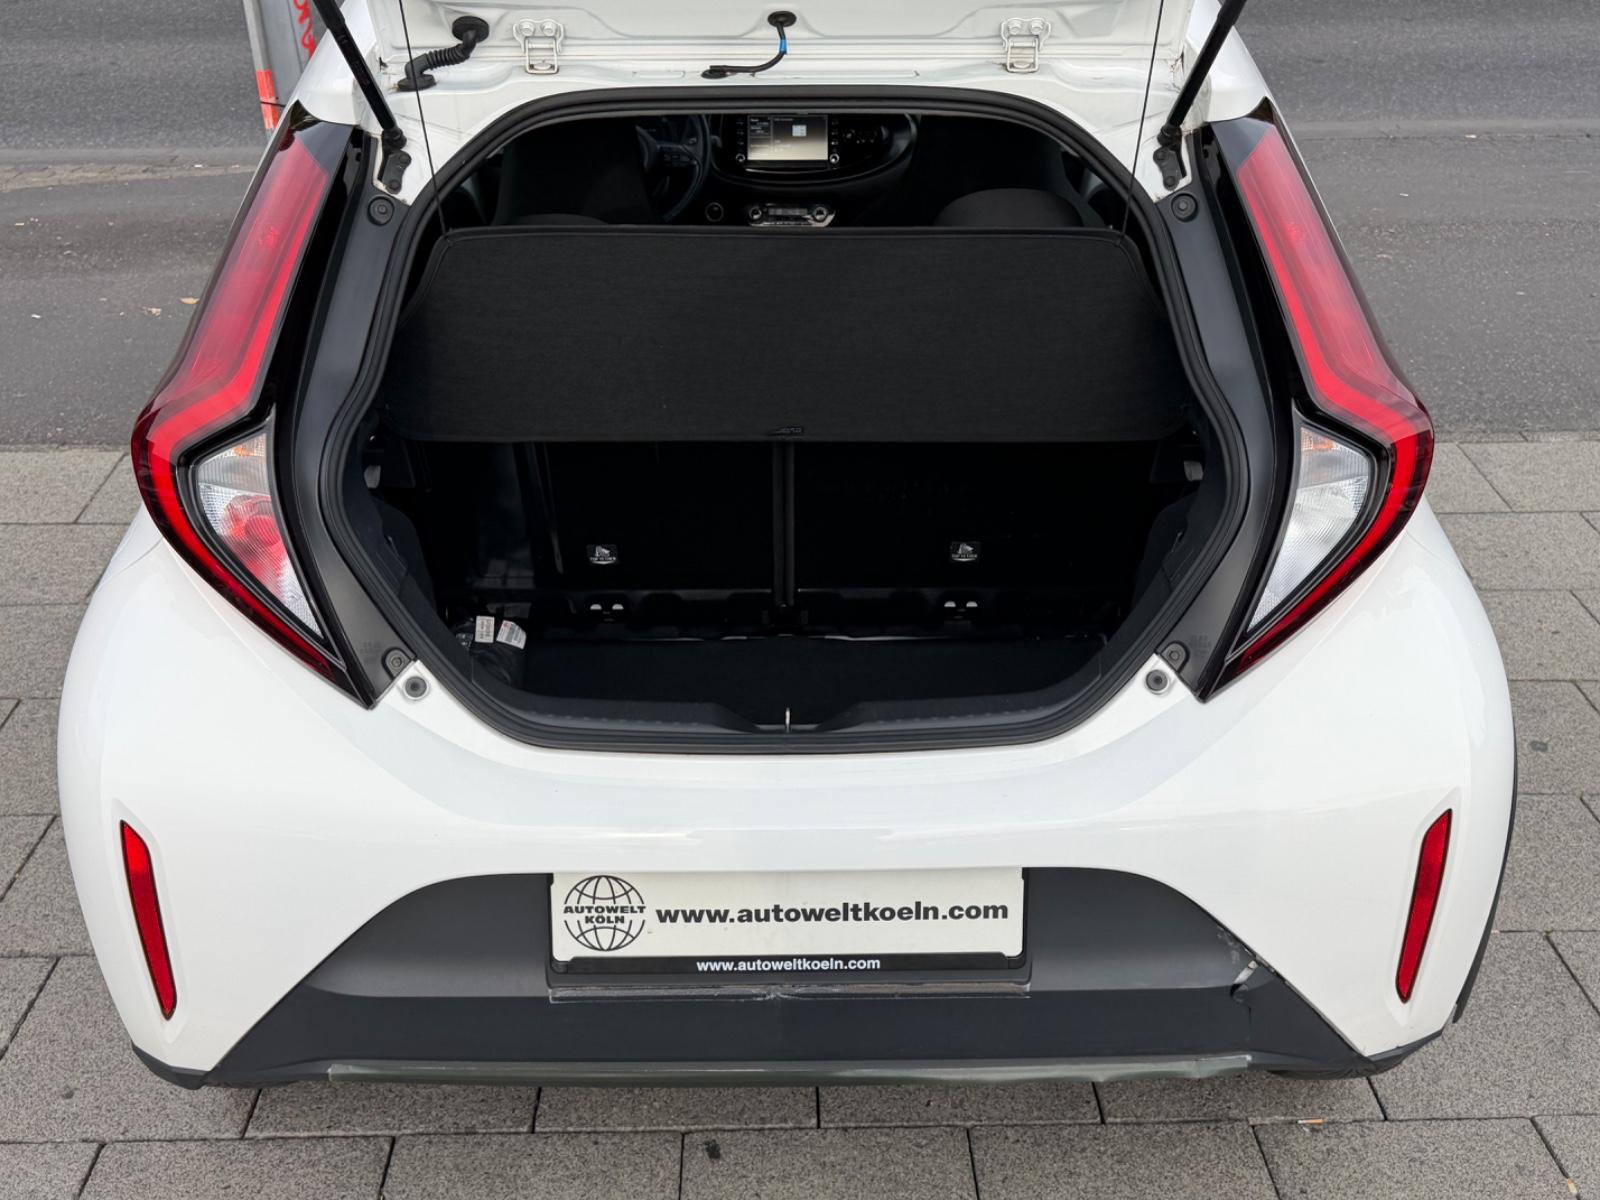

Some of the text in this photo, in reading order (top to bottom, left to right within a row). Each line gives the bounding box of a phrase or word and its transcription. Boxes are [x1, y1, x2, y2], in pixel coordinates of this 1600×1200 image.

[563, 905, 646, 914] AUTOWELT
[656, 901, 1008, 923] www.autoweltkoeln.com
[584, 915, 625, 924] KÖLN
[696, 958, 880, 971] www.autoweltkoeln.com
